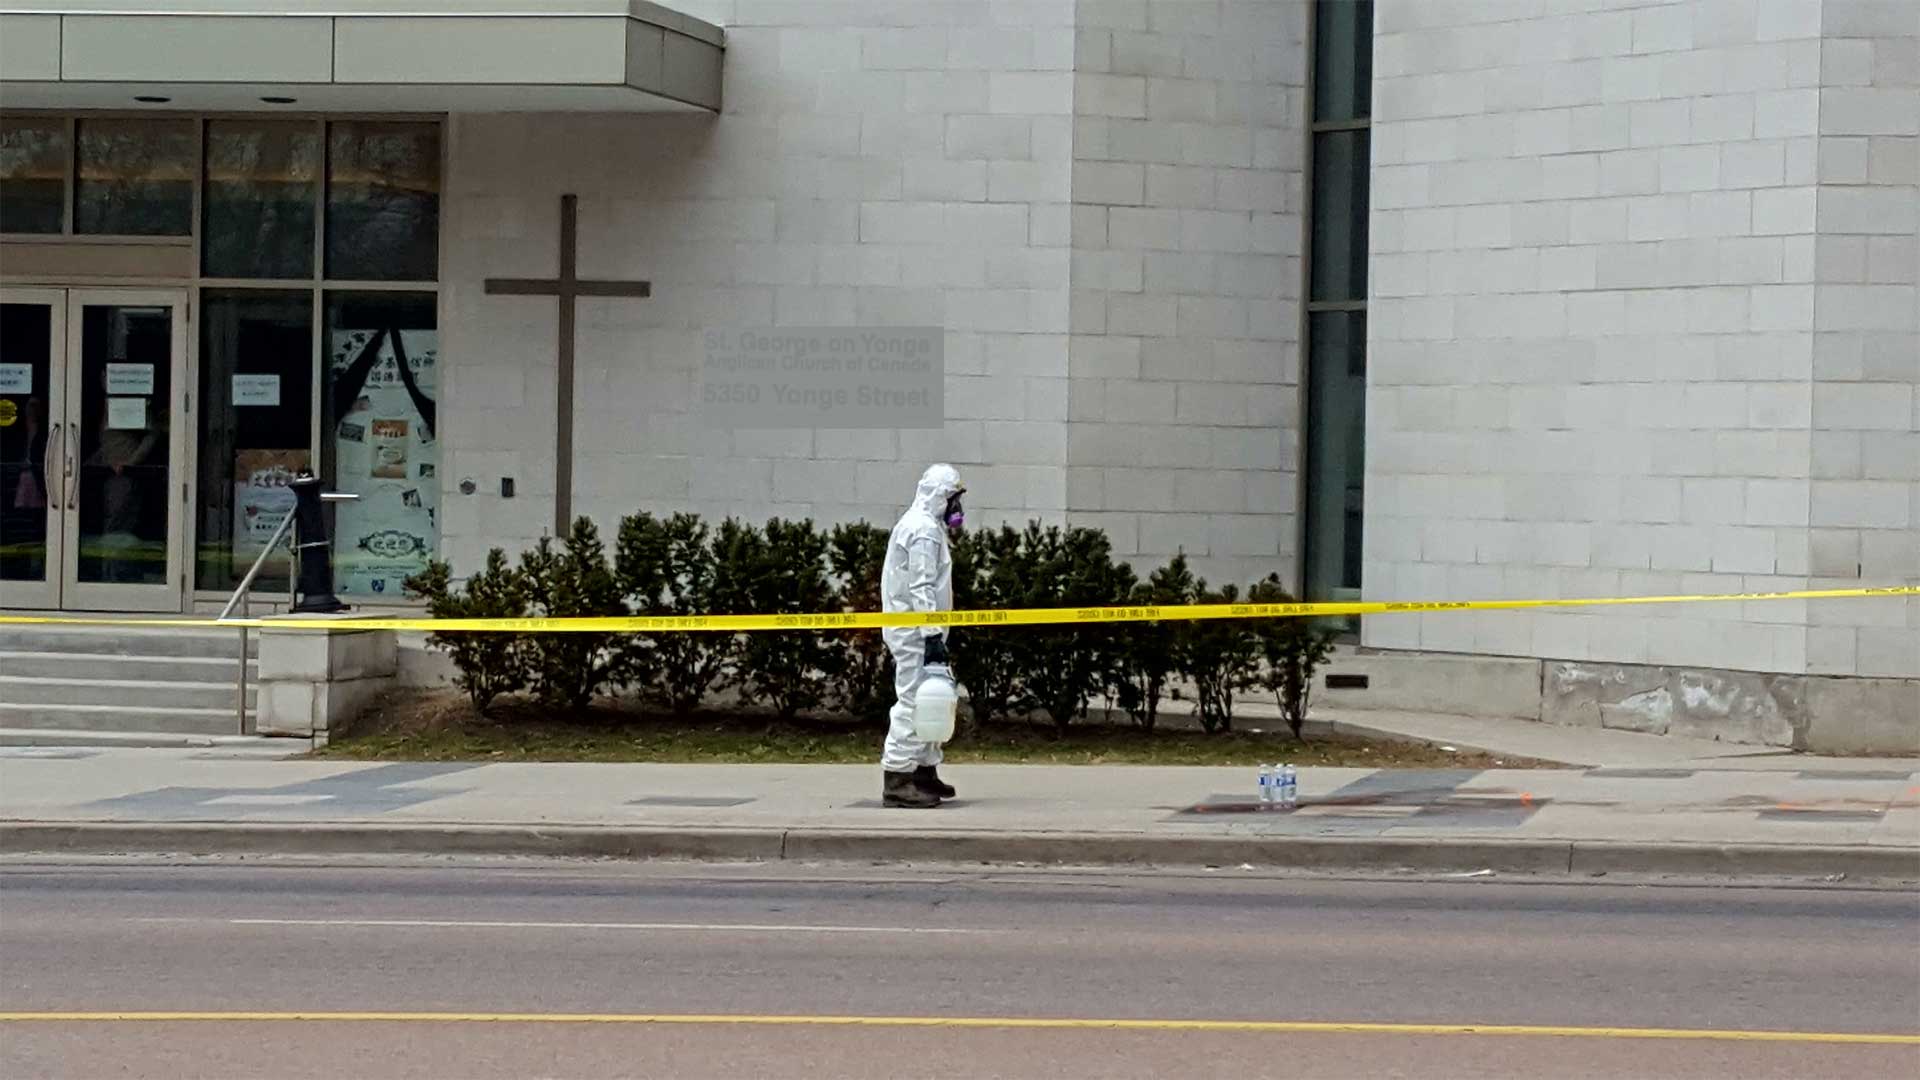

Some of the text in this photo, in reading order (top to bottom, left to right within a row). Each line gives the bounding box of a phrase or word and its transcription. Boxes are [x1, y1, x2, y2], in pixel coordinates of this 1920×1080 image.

[704, 330, 931, 358] St. George on Yonge
[704, 353, 931, 372] Anglican Church of Canada
[704, 384, 930, 411] 5350 Yonge Street
